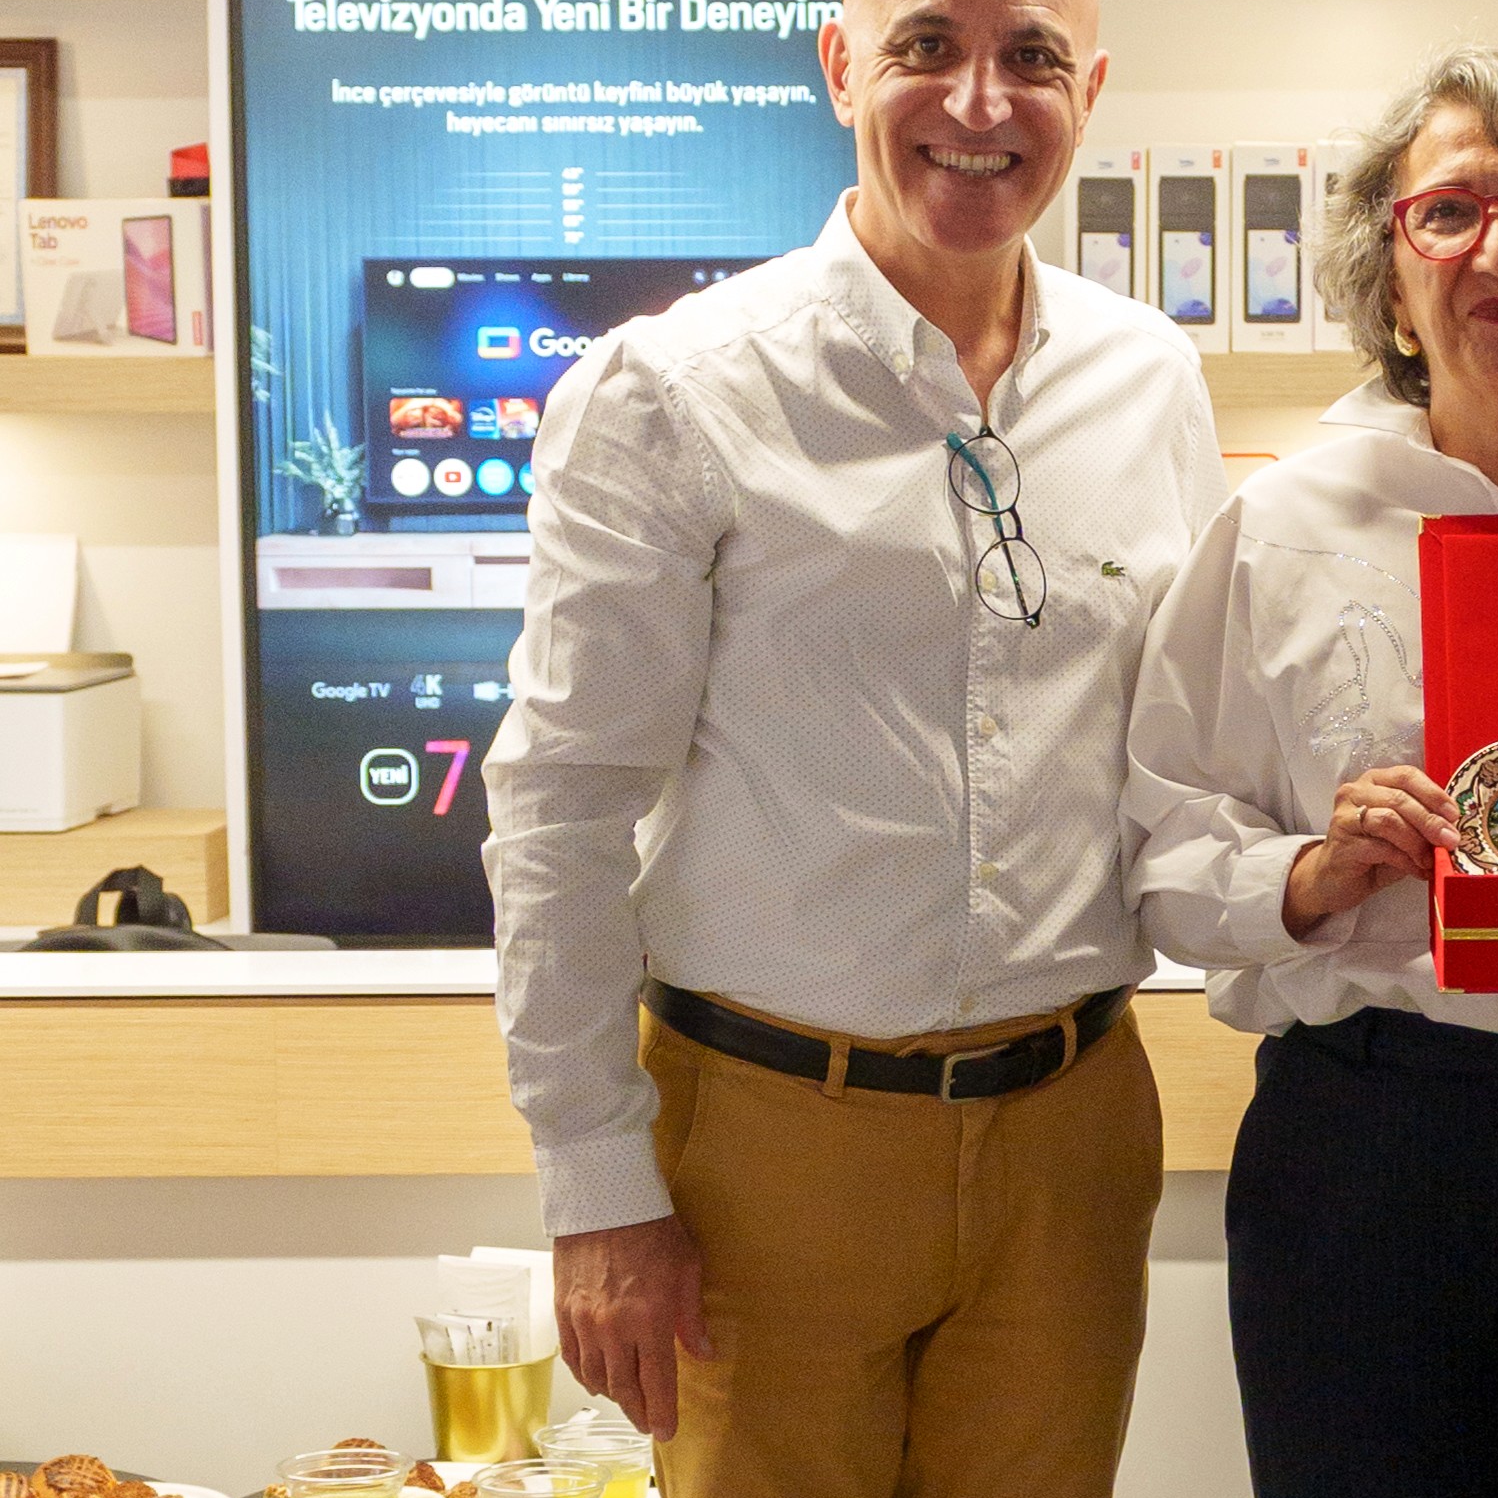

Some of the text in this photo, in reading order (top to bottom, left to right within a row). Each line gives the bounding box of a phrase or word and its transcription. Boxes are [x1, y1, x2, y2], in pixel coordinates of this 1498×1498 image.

[332, 78, 817, 108] İnce çerçevesiyle görüntü keyfini büyük yaşayın.
[446, 110, 704, 137] heyecanı sınırsız yaşayın.
[28, 212, 88, 230] Lenovo
[30, 232, 58, 251] Tab
[311, 681, 391, 702] Google TV
[410, 674, 443, 696] 4K
[369, 764, 409, 786] YENİ
[425, 740, 470, 816] 7
